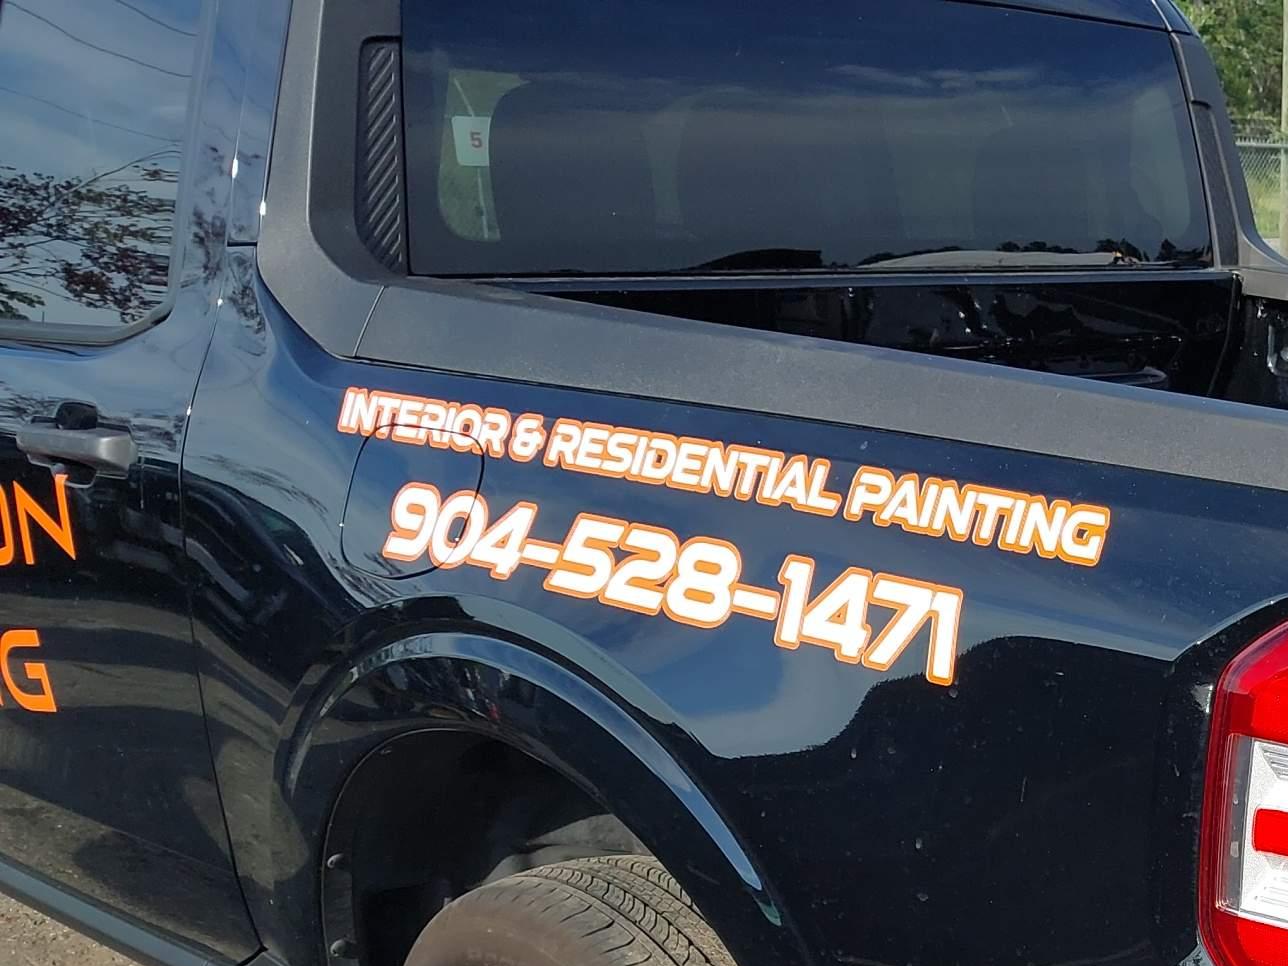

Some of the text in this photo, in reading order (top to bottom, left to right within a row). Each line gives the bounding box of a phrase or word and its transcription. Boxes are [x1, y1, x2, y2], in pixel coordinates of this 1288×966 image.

[469, 131, 483, 149] 5
[337, 387, 1110, 567] INTERIOR & RESIDENTIAL PAINTING
[383, 481, 965, 686] 904-528-1471
